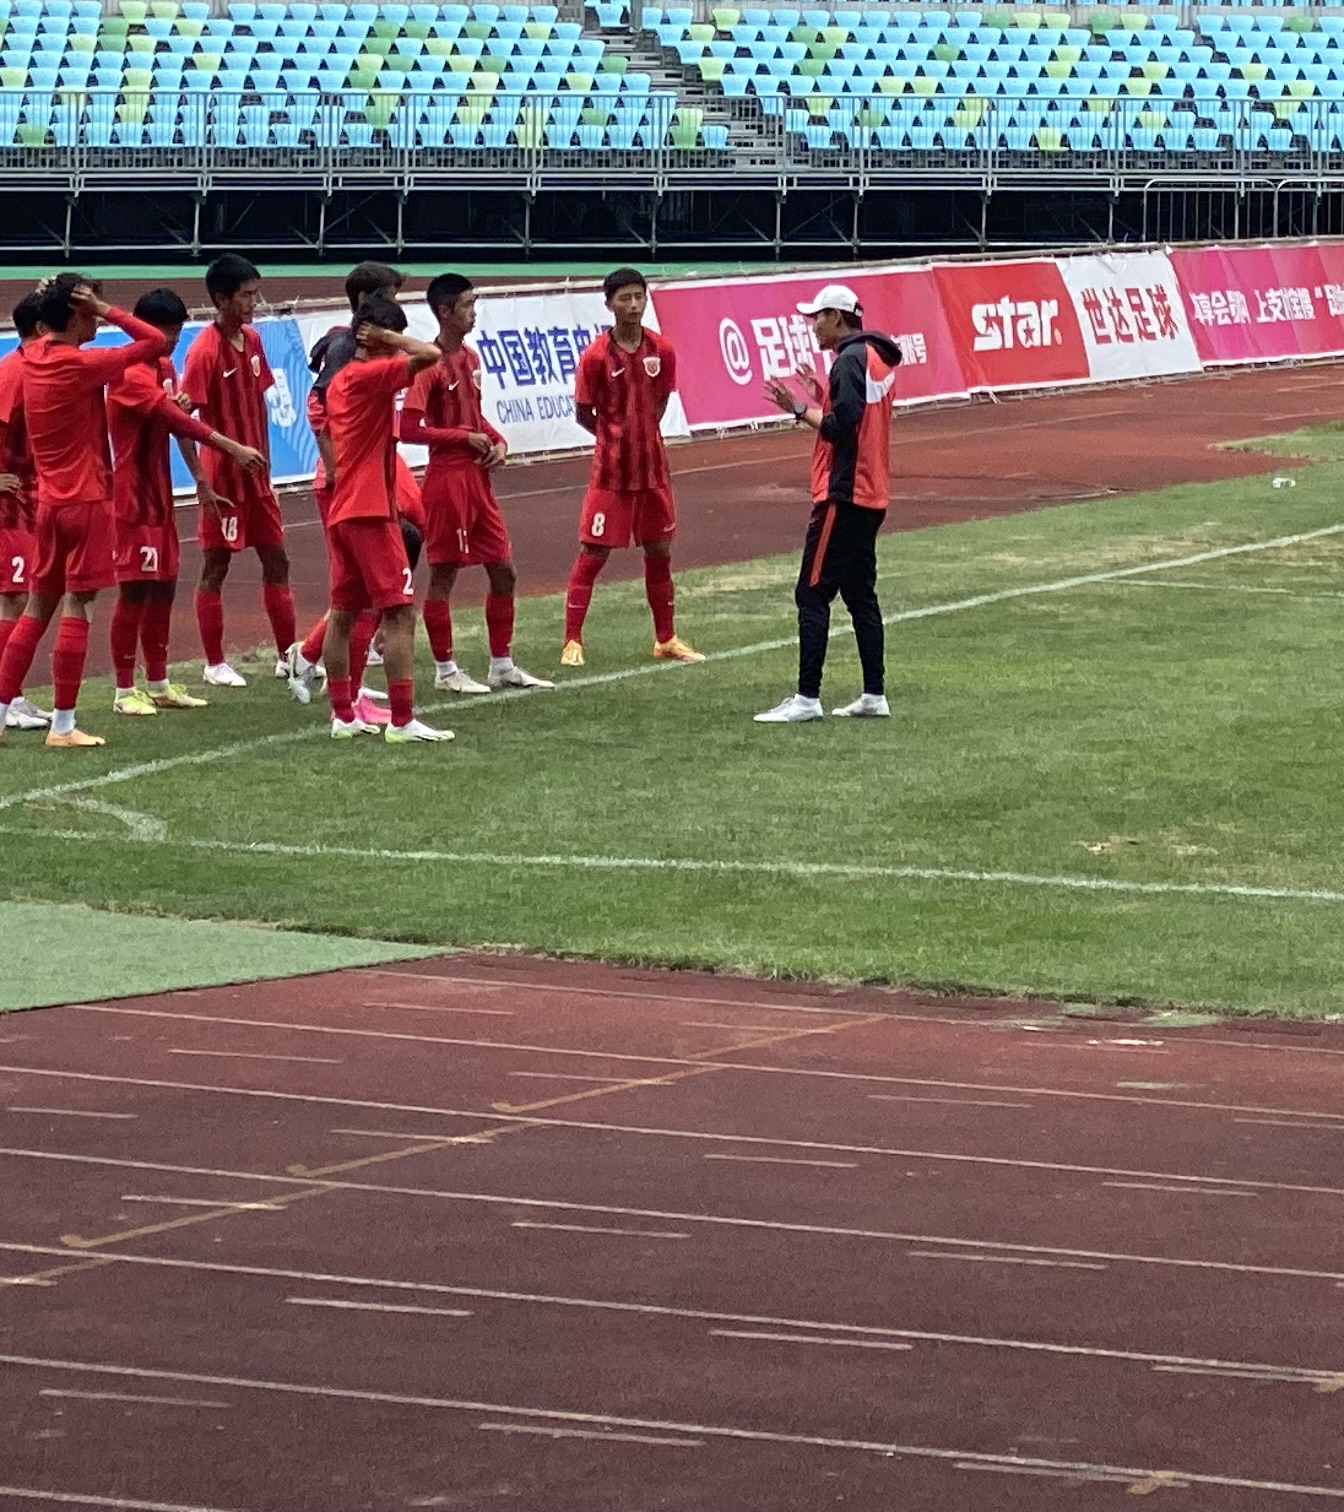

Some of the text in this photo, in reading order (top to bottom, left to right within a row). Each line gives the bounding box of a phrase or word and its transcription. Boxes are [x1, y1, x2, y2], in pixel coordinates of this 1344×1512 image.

[1081, 284, 1180, 345] 世达足球
[497, 398, 534, 424] CHINA
[591, 512, 606, 537] 8
[11, 556, 25, 584] 2
